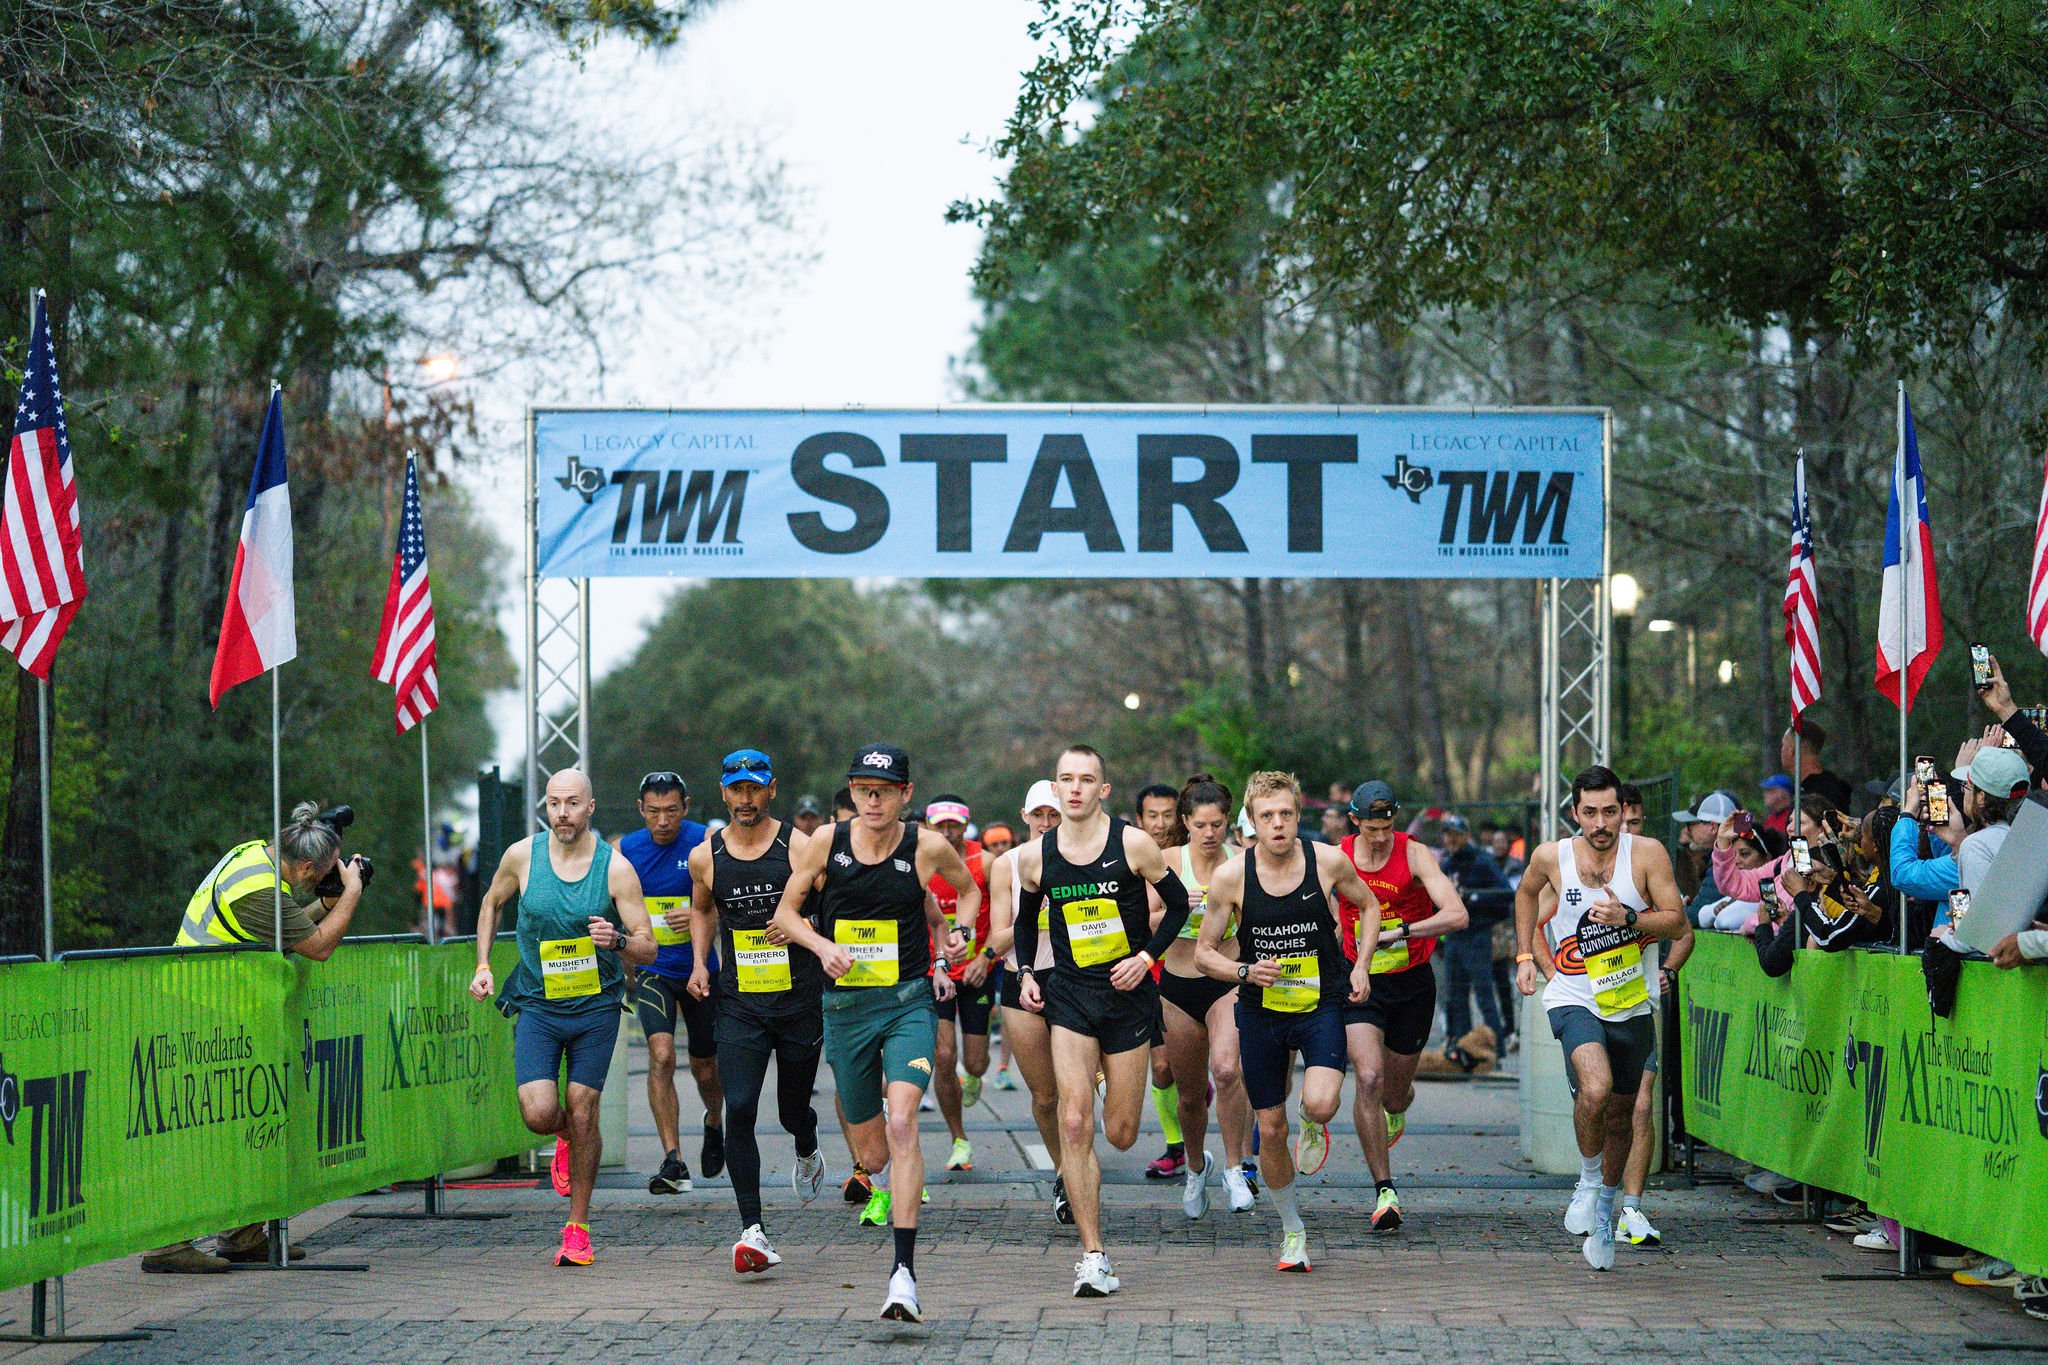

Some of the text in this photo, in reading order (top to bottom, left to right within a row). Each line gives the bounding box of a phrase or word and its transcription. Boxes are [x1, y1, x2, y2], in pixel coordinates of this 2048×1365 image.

[584, 431, 760, 450] LEGACY CAPITAL
[1409, 432, 1580, 451] LEGACY CAPITAL
[786, 431, 1359, 555] START
[609, 469, 750, 544] TWM
[1437, 470, 1575, 545] TWM
[610, 547, 744, 556] THE WOODLANDS MARATHON
[1437, 547, 1569, 556] THE WOODLANDS MARATHON
[733, 883, 773, 896] MIND
[1051, 880, 1119, 899] EDINAXC
[726, 896, 776, 909] MATTE
[1380, 911, 1395, 919] LUB
[1081, 921, 1107, 932] DAVIS
[1252, 921, 1319, 936] OKLAHOMA
[849, 946, 883, 954] BREEN
[1254, 938, 1306, 950] COACHES
[1579, 932, 1620, 954] RUNNING
[548, 958, 590, 968] MUSHETT
[737, 950, 786, 959] GUERRERO
[1596, 966, 1638, 986] WALLACE
[156, 1025, 253, 1070] The Woodlands
[126, 1035, 290, 1141] MARATHON
[244, 1119, 290, 1151] MGMT
